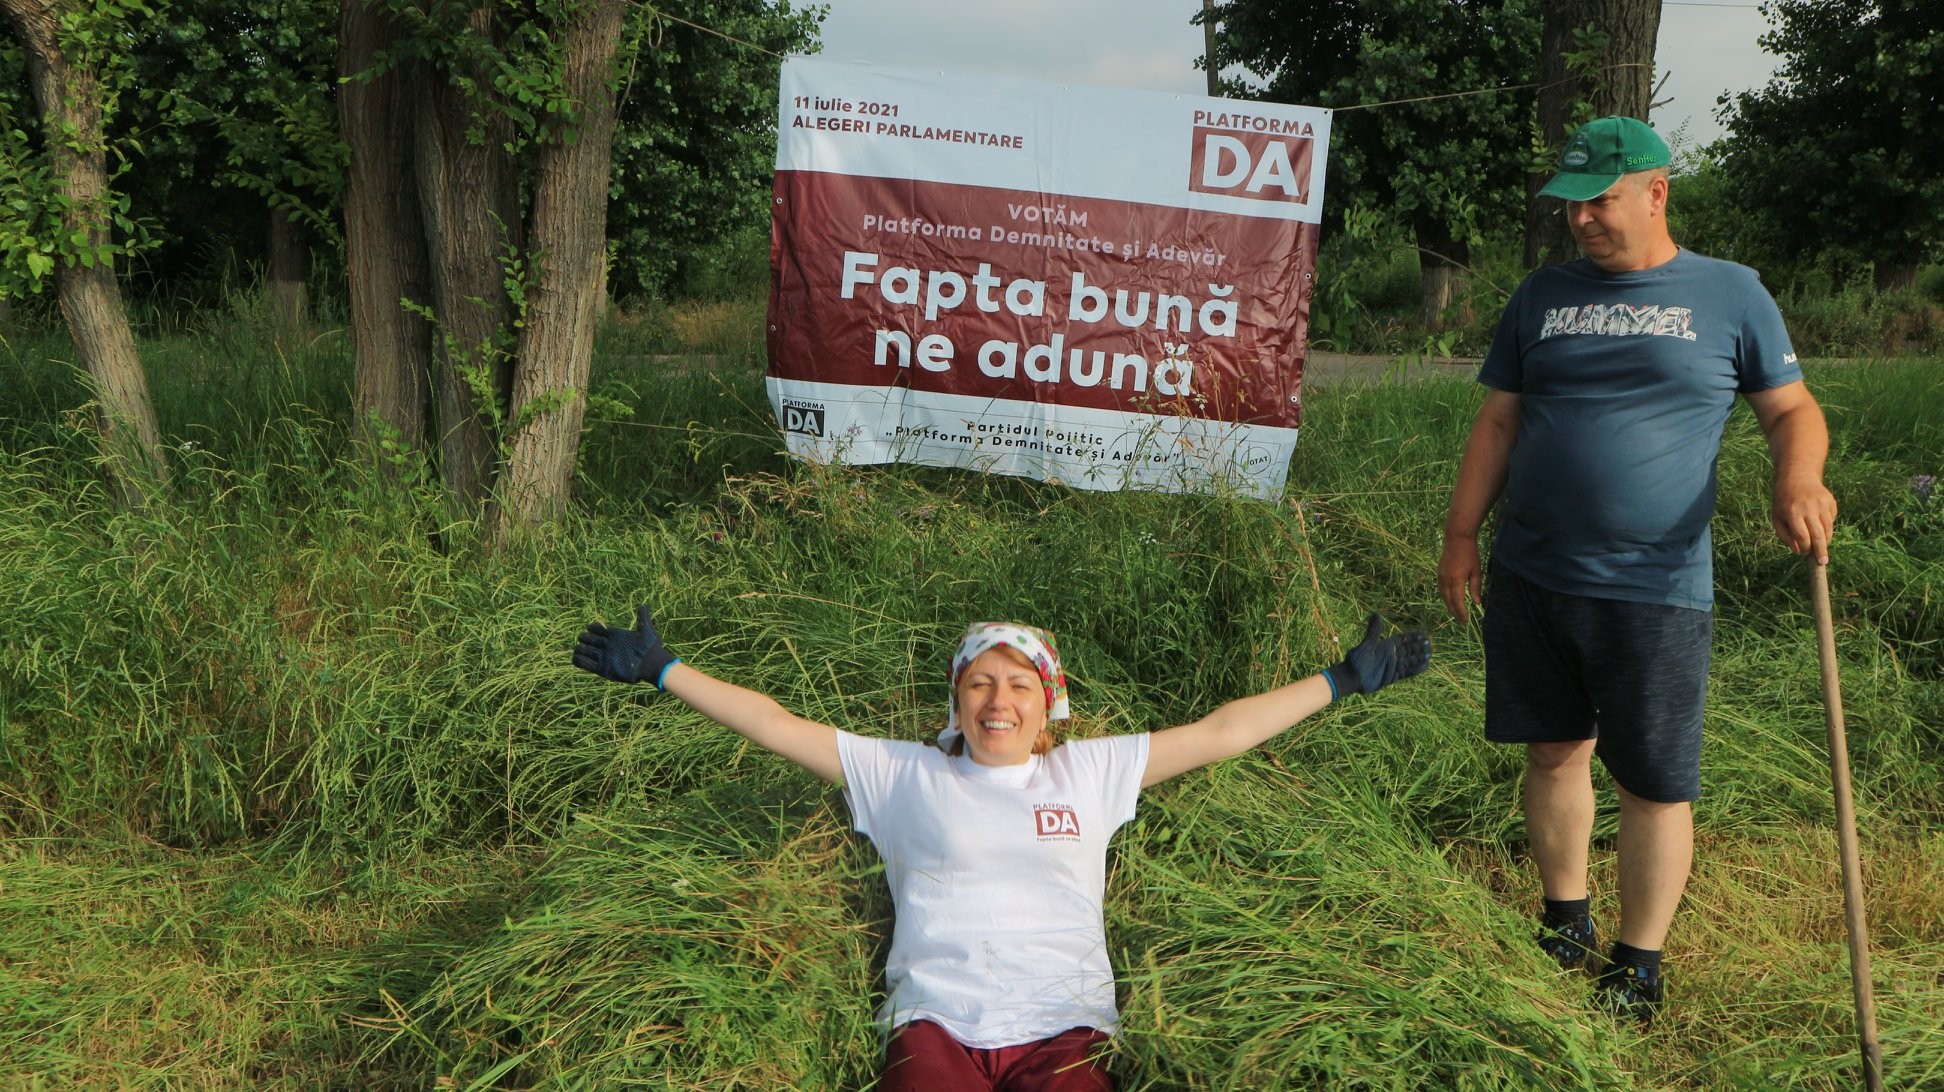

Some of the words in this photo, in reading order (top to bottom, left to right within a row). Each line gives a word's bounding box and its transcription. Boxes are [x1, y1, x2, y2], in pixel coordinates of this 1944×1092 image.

[794, 96, 810, 109] 11
[815, 96, 853, 113] iulie
[858, 101, 899, 117] 2021
[792, 115, 870, 133] ALEGERI
[876, 122, 1024, 149] PARLAMENTARE
[1193, 110, 1315, 136] PLATFORMA
[1202, 133, 1300, 197] DA
[1007, 203, 1088, 227] VOTĂM
[863, 214, 982, 241] Platforma
[990, 225, 1115, 254] Demnitate
[1122, 242, 1140, 262] și
[1146, 242, 1227, 267] Adevăr
[840, 250, 1047, 321] Fapta
[1068, 271, 1239, 337] bună
[874, 328, 955, 372] ne
[977, 333, 1195, 397] adună
[1783, 353, 1797, 365] hu
[782, 398, 825, 410] PLATFORMA
[787, 407, 820, 435] DA
[967, 422, 1038, 437] Partidul
[992, 436, 1084, 457] Demnitate
[1249, 455, 1268, 466] OTAT
[1040, 811, 1079, 834] DA
